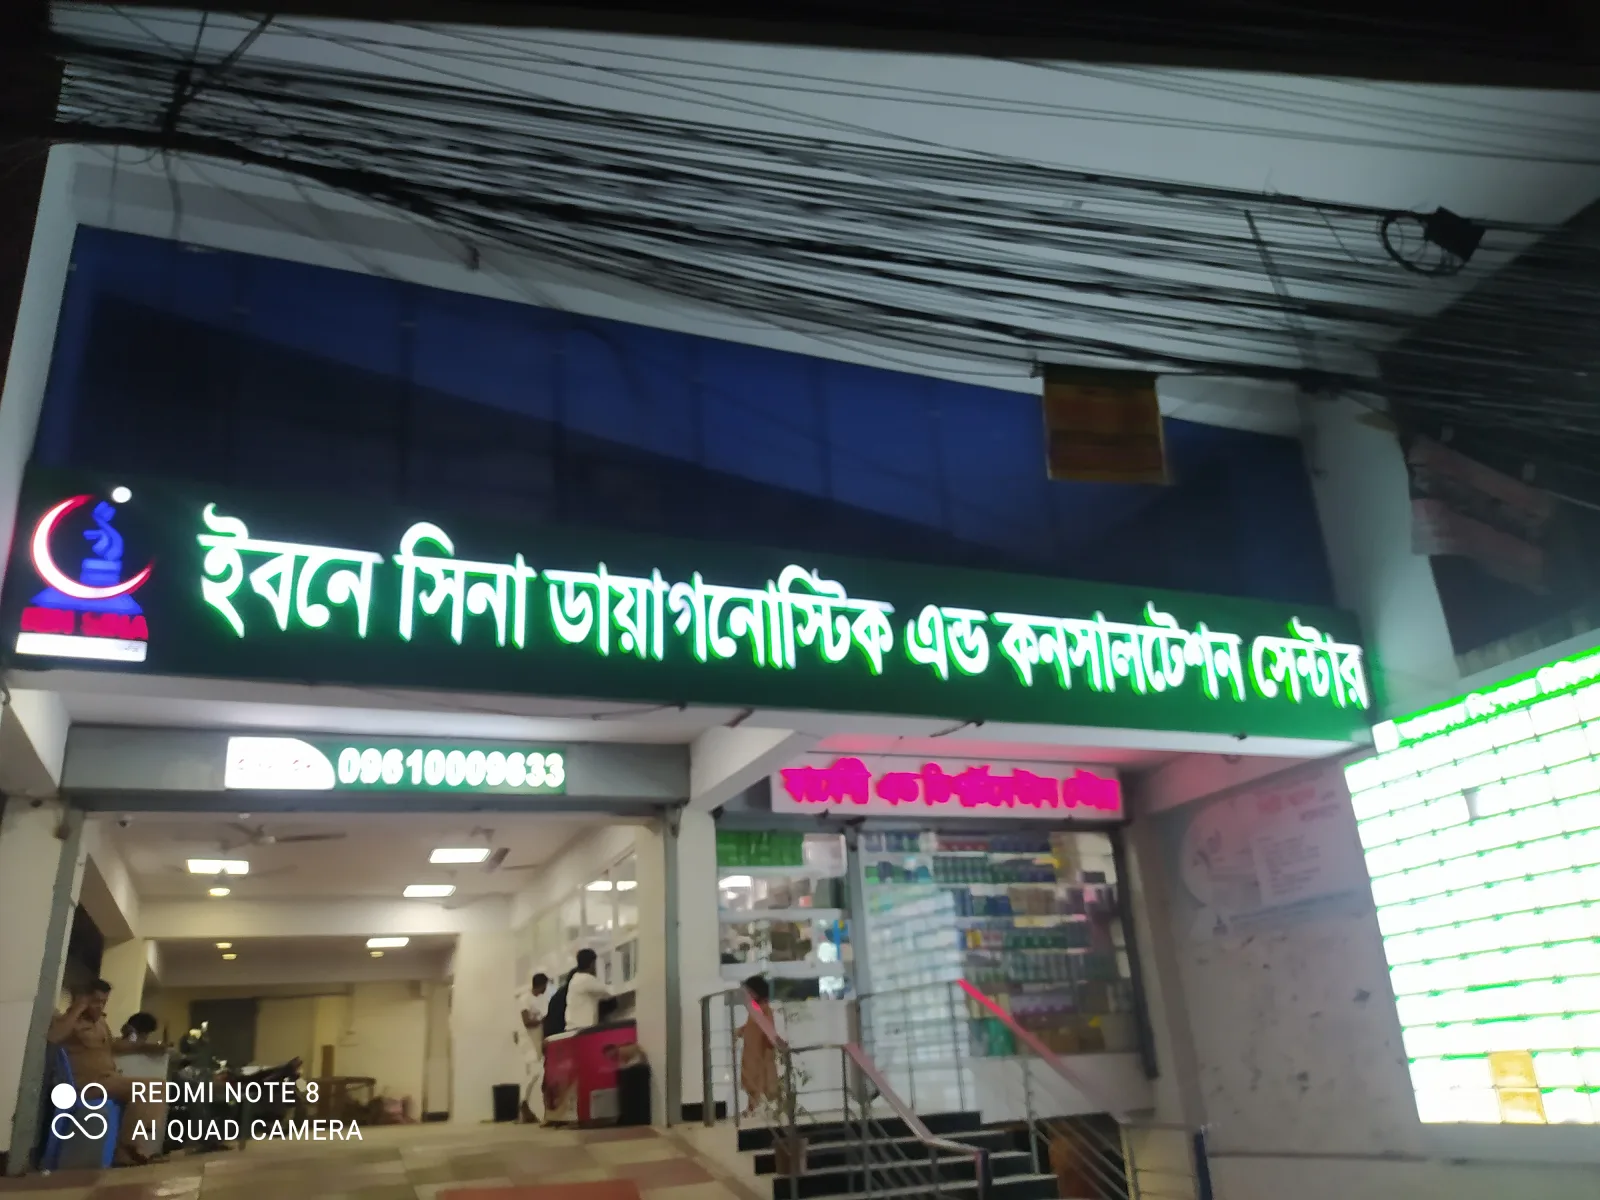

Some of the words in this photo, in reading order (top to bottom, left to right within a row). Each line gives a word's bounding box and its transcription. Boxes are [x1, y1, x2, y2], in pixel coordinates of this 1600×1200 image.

[196, 503, 384, 638] ইবনে
[393, 522, 537, 649] সিনা
[542, 563, 895, 675] ডায়াগনোস্টিক
[904, 604, 989, 680] এন্ড
[991, 601, 1245, 702] কনসালটেশন
[1250, 617, 1369, 709] সেন্টার
[337, 746, 566, 788] 09610009633
